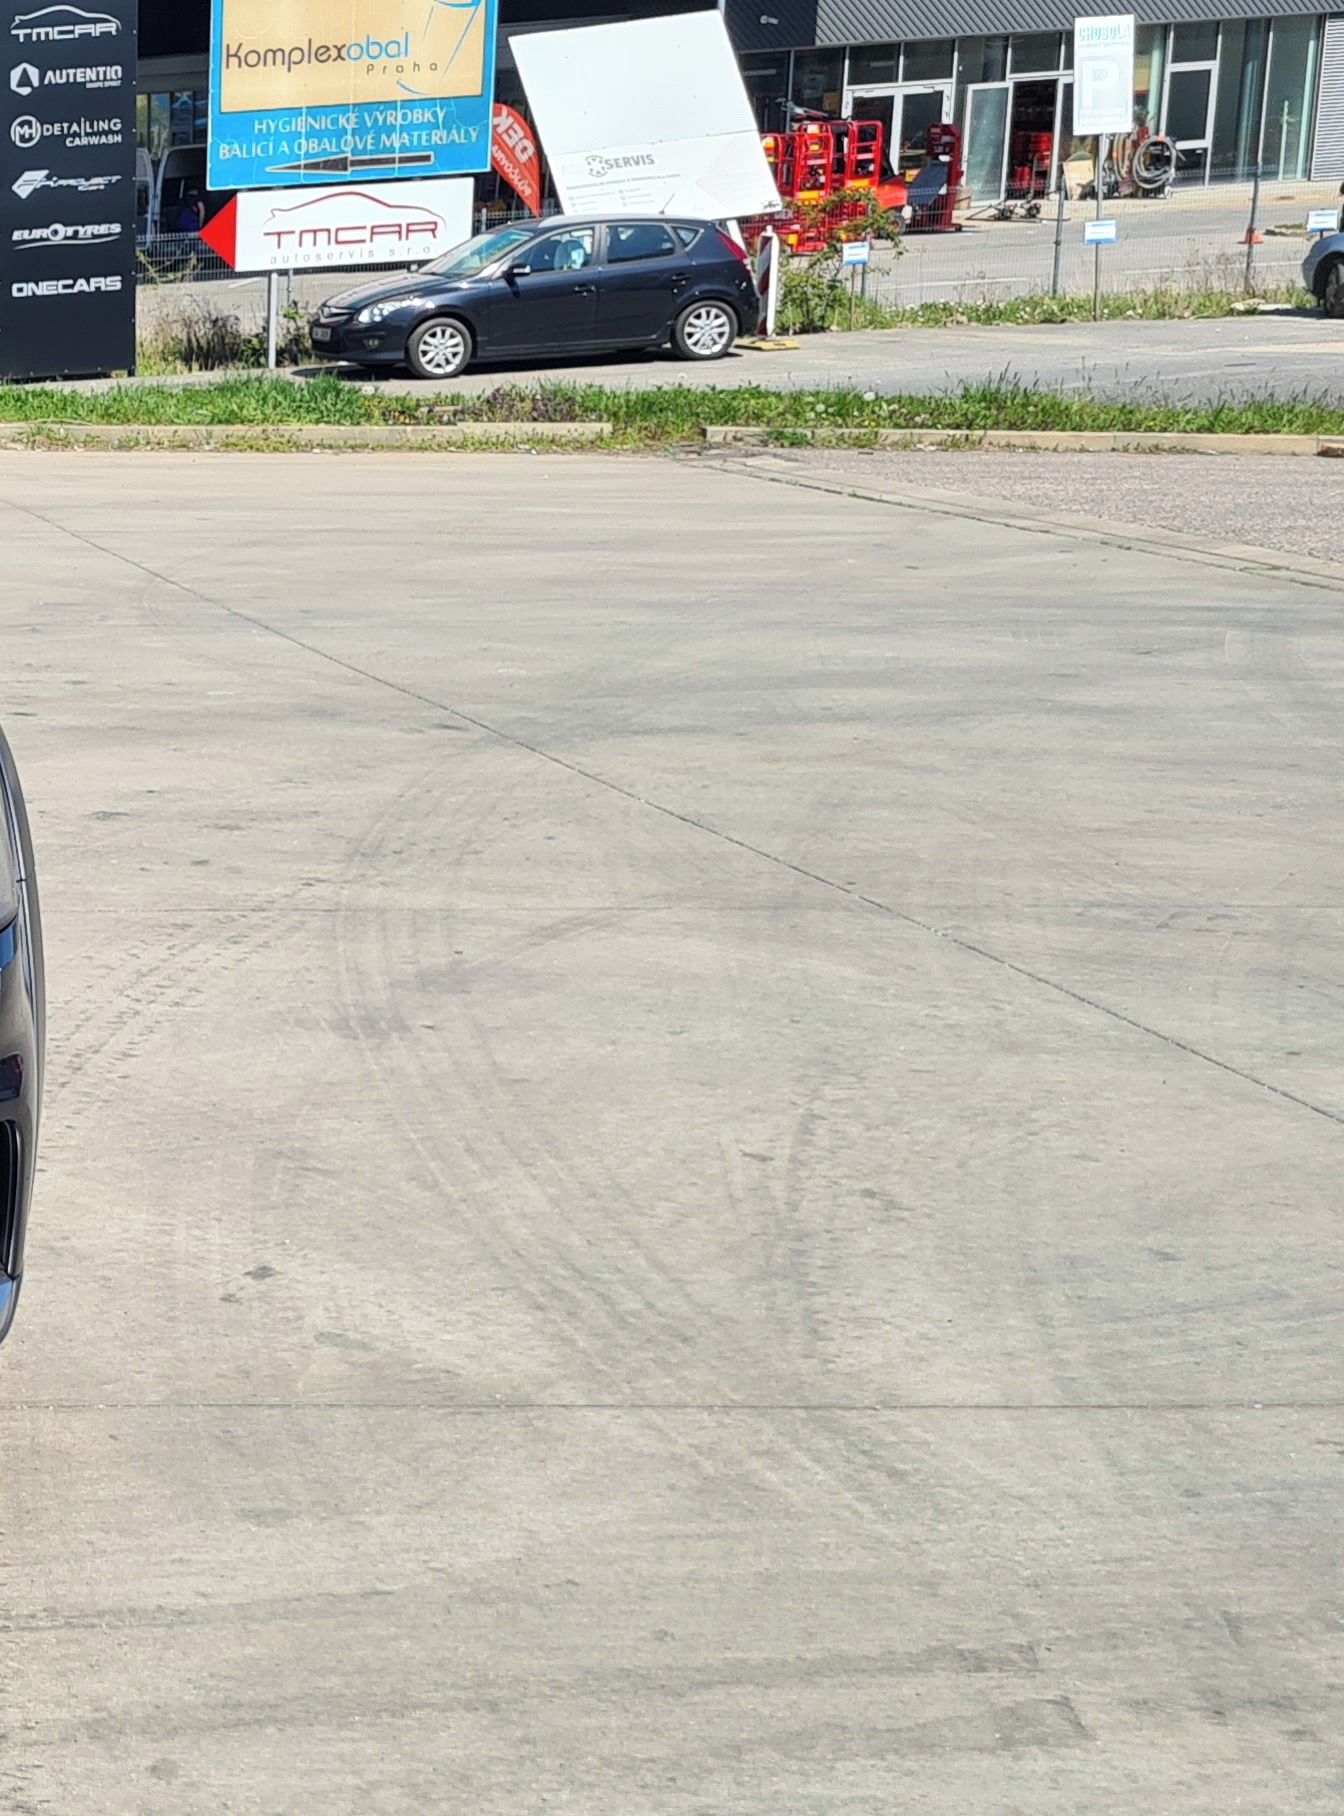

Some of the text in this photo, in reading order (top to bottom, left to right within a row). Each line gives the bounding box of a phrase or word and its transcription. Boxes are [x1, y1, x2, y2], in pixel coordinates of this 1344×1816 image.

[10, 22, 118, 43] TMCAR
[225, 31, 409, 73] Komplexobal
[366, 61, 438, 75] Praha
[43, 117, 122, 137] DETAILING
[254, 107, 447, 134] HYGIENICKÉ VÝROBKY
[65, 134, 122, 147] CARWASH
[219, 126, 480, 160] BALICÍ A OBALOVÉ MATERIÁLY
[605, 153, 656, 170] SERVIS
[12, 223, 122, 241] EUROTYRES
[263, 221, 438, 249] TMCAR
[270, 245, 438, 265] autoservis s.r.o.
[11, 275, 122, 298] ONECARS
